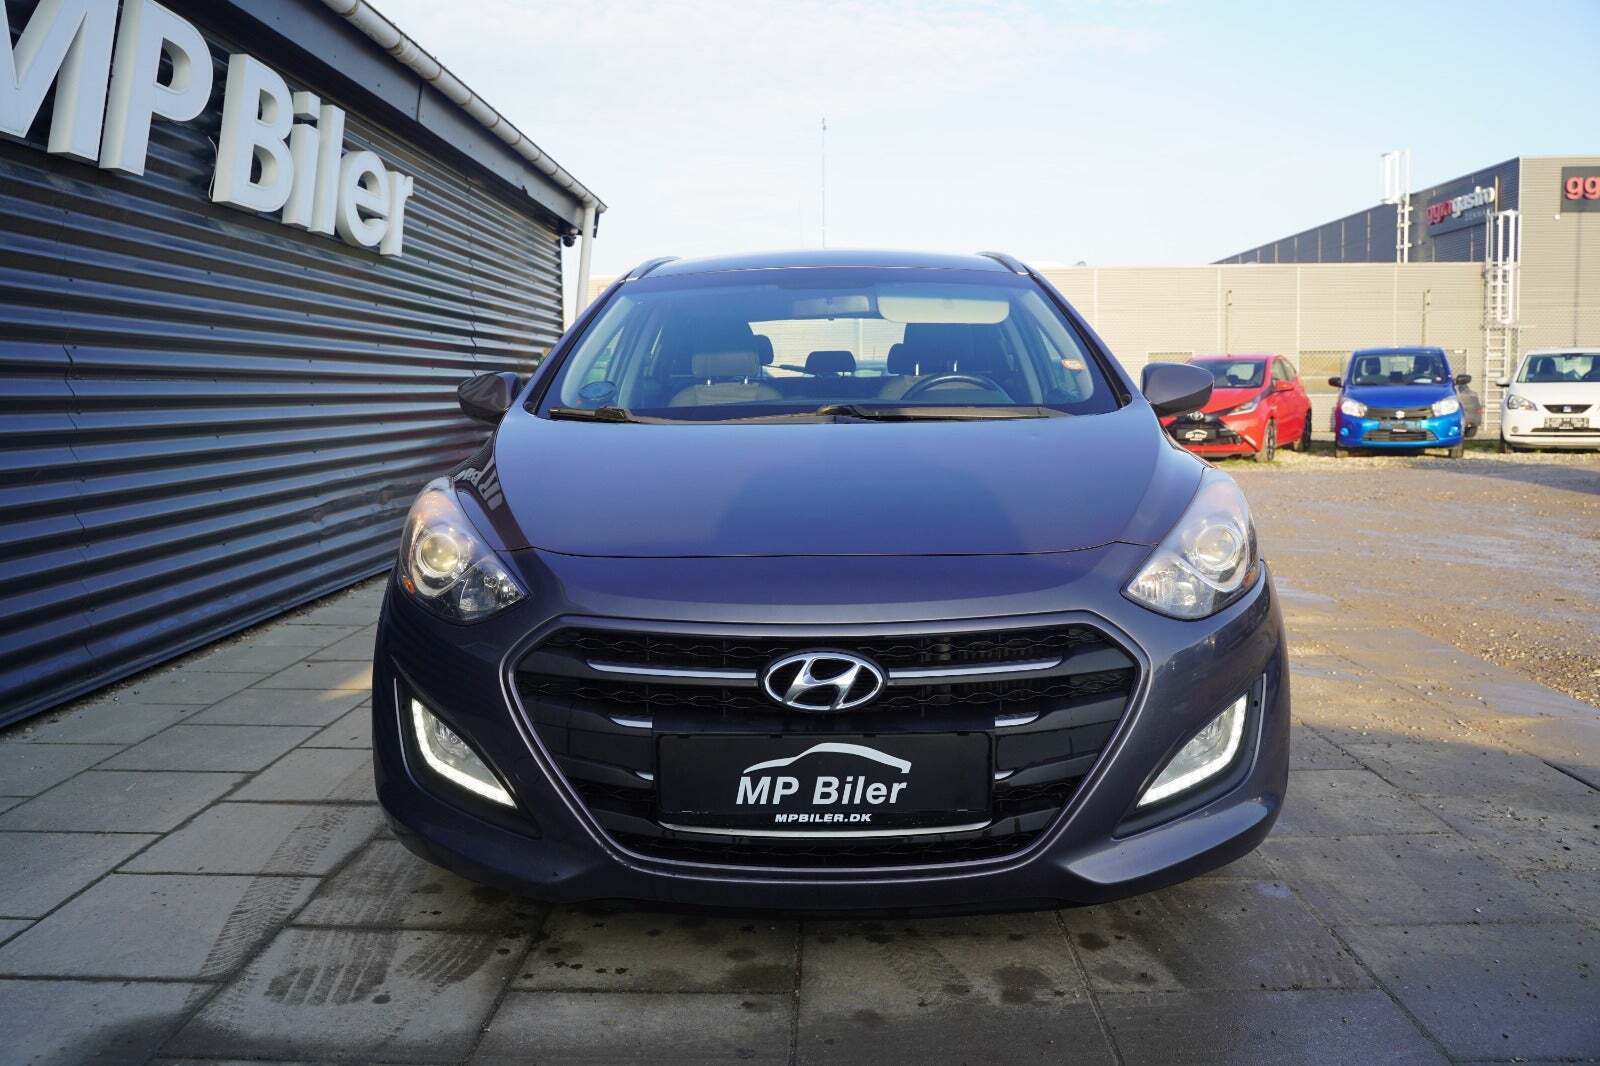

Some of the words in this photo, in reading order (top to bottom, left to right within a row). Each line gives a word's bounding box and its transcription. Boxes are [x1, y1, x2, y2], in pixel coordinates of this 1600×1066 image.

[0, 0, 213, 176] MP
[212, 53, 413, 257] Biler
[735, 775, 800, 805] MP
[812, 775, 908, 805] Biler
[774, 813, 873, 824] MPBILER.DK
